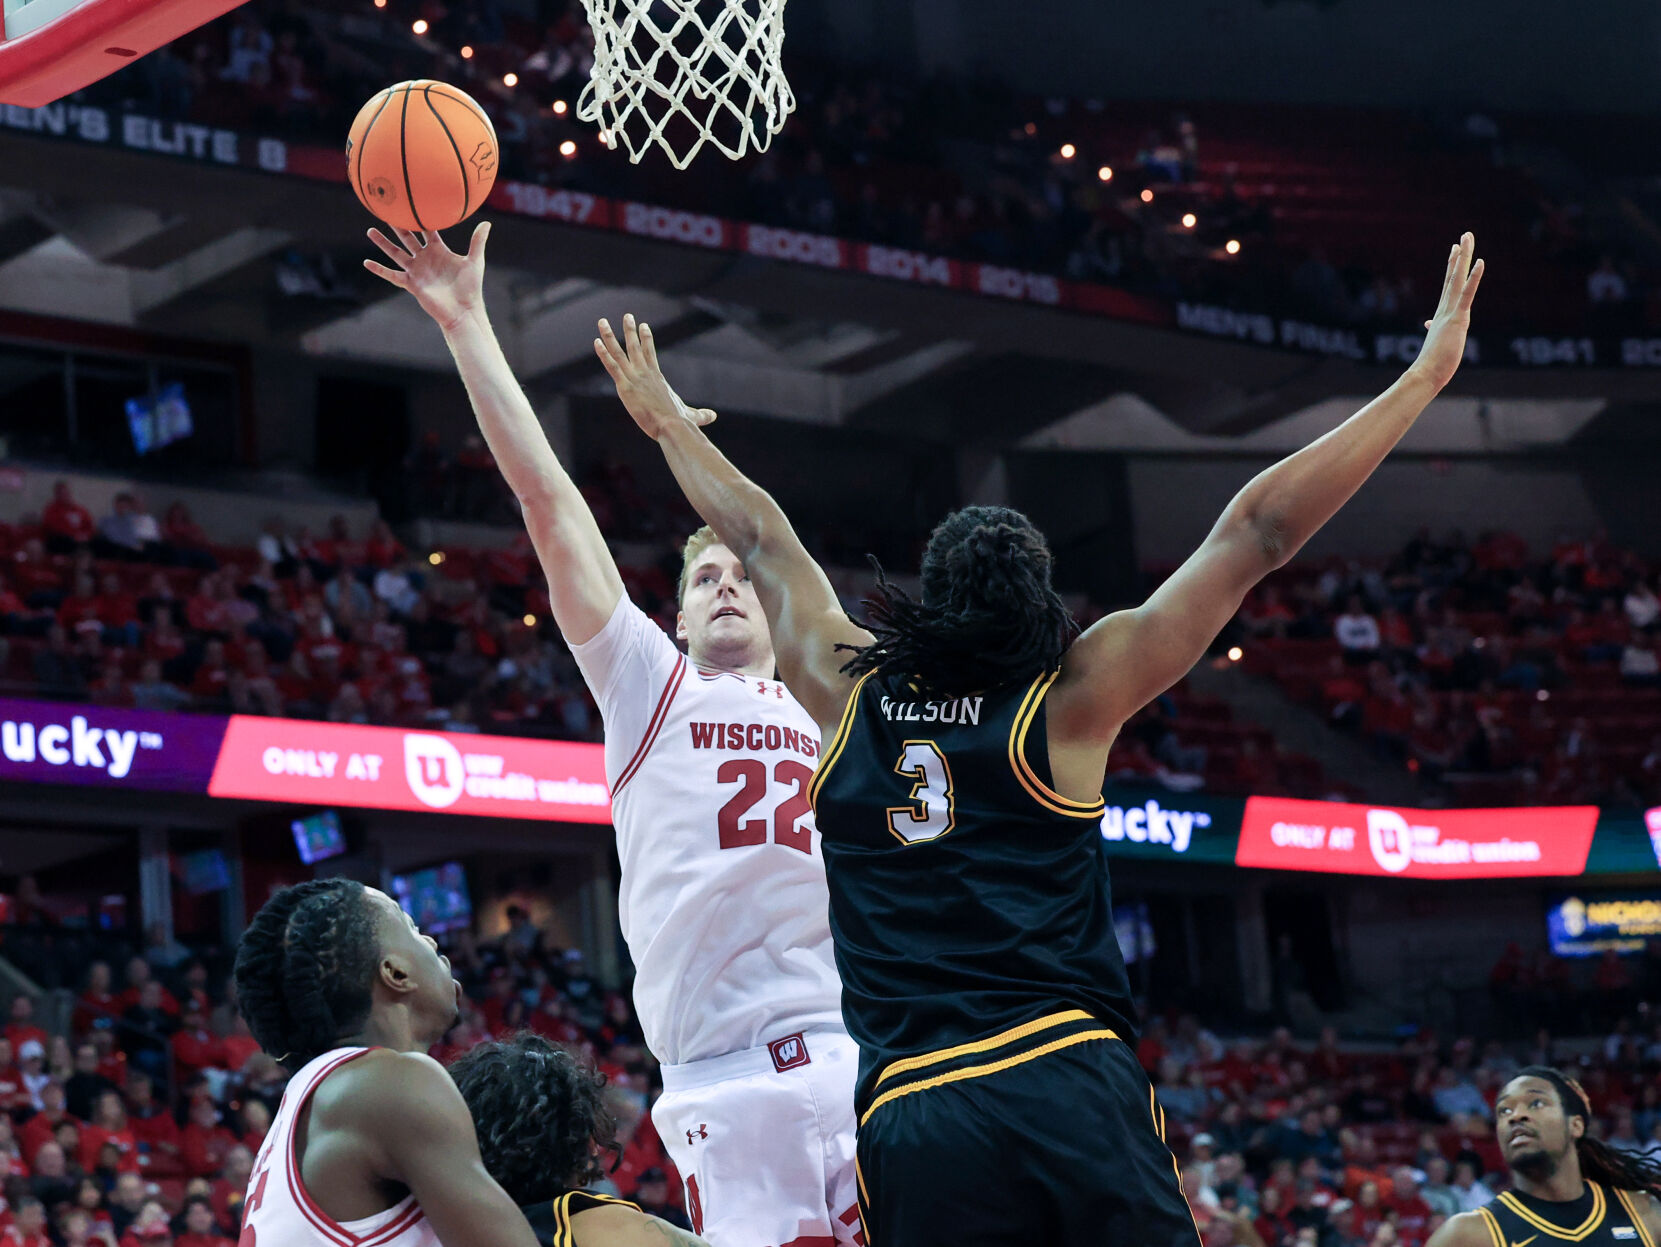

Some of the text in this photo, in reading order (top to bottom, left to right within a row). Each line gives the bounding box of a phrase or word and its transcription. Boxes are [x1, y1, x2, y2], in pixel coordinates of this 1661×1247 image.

[0, 104, 109, 142] EN'S
[122, 113, 239, 165] ELITE
[624, 202, 723, 249] 2000
[881, 695, 983, 726] WILSON
[262, 746, 383, 782] ONLY AT
[717, 759, 814, 855] 22
[886, 739, 955, 846] 3
